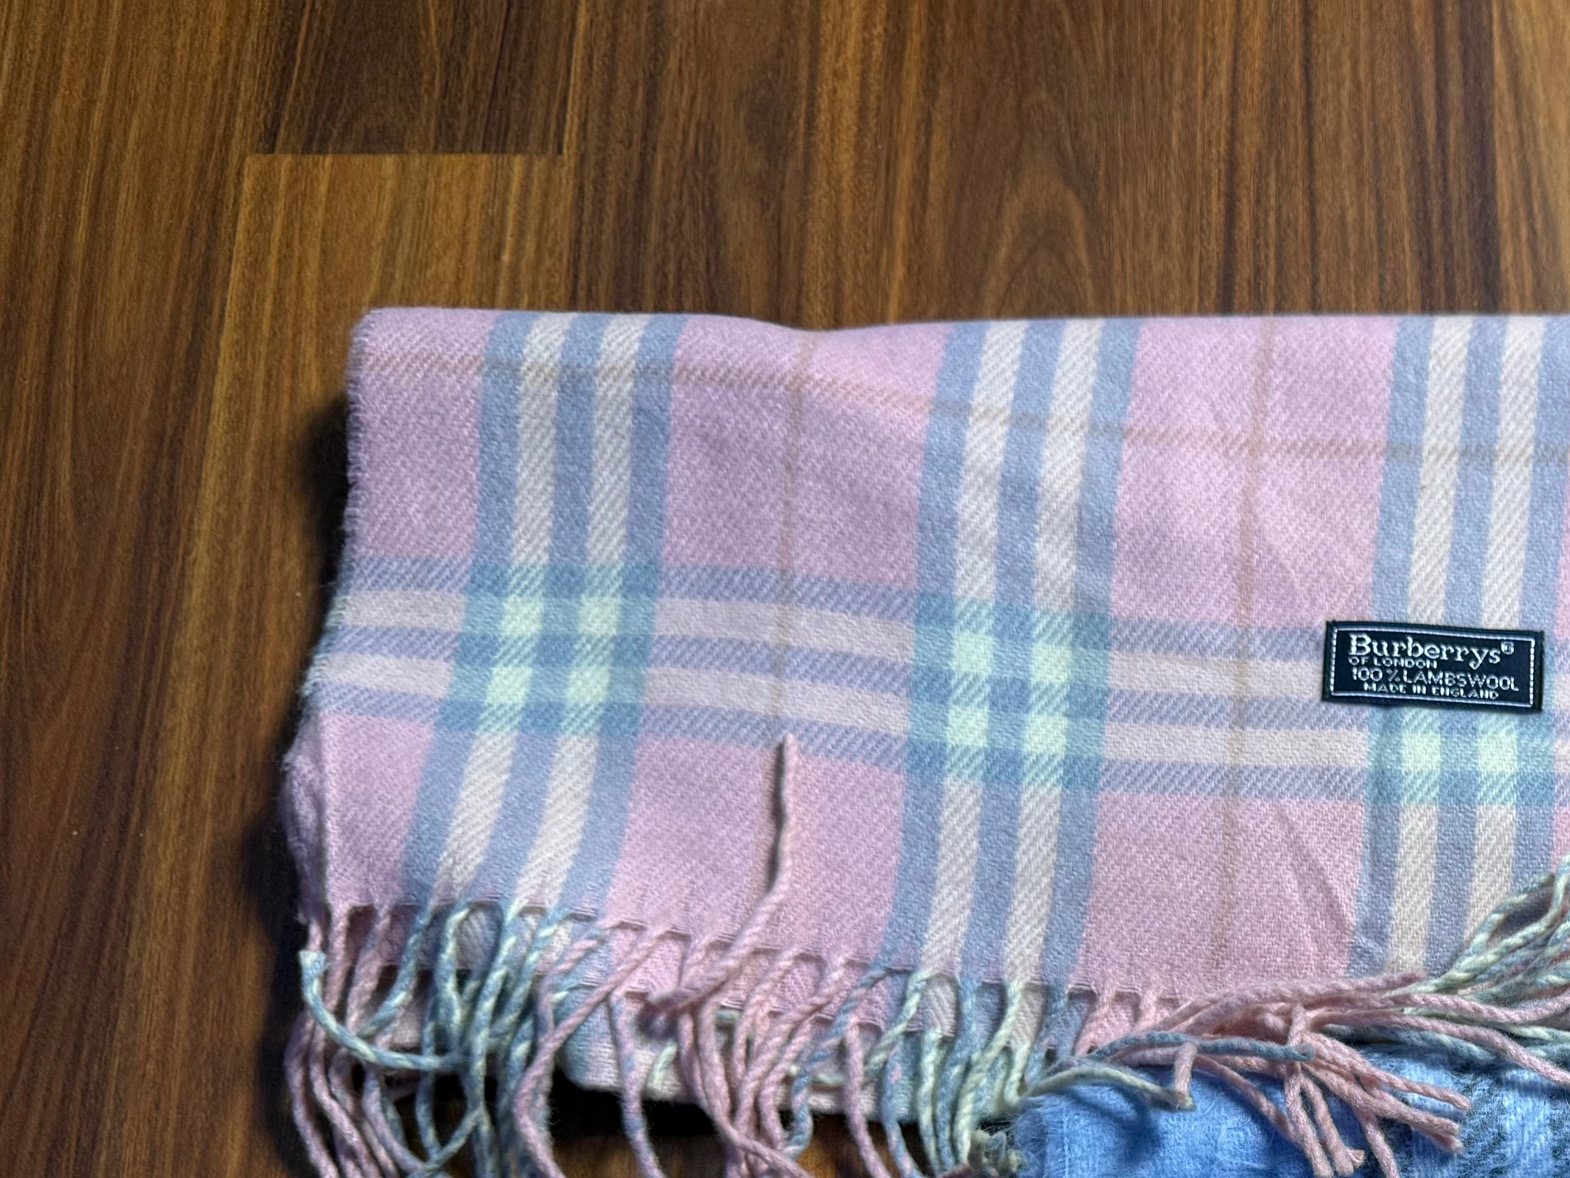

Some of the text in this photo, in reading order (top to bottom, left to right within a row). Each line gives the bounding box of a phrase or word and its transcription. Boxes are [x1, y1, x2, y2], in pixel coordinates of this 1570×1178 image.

[1348, 656, 1438, 669] OF LONDON
[1403, 669, 1520, 692] LAMBSWOOL
[1363, 682, 1500, 700] MADE IN ENGLAND
